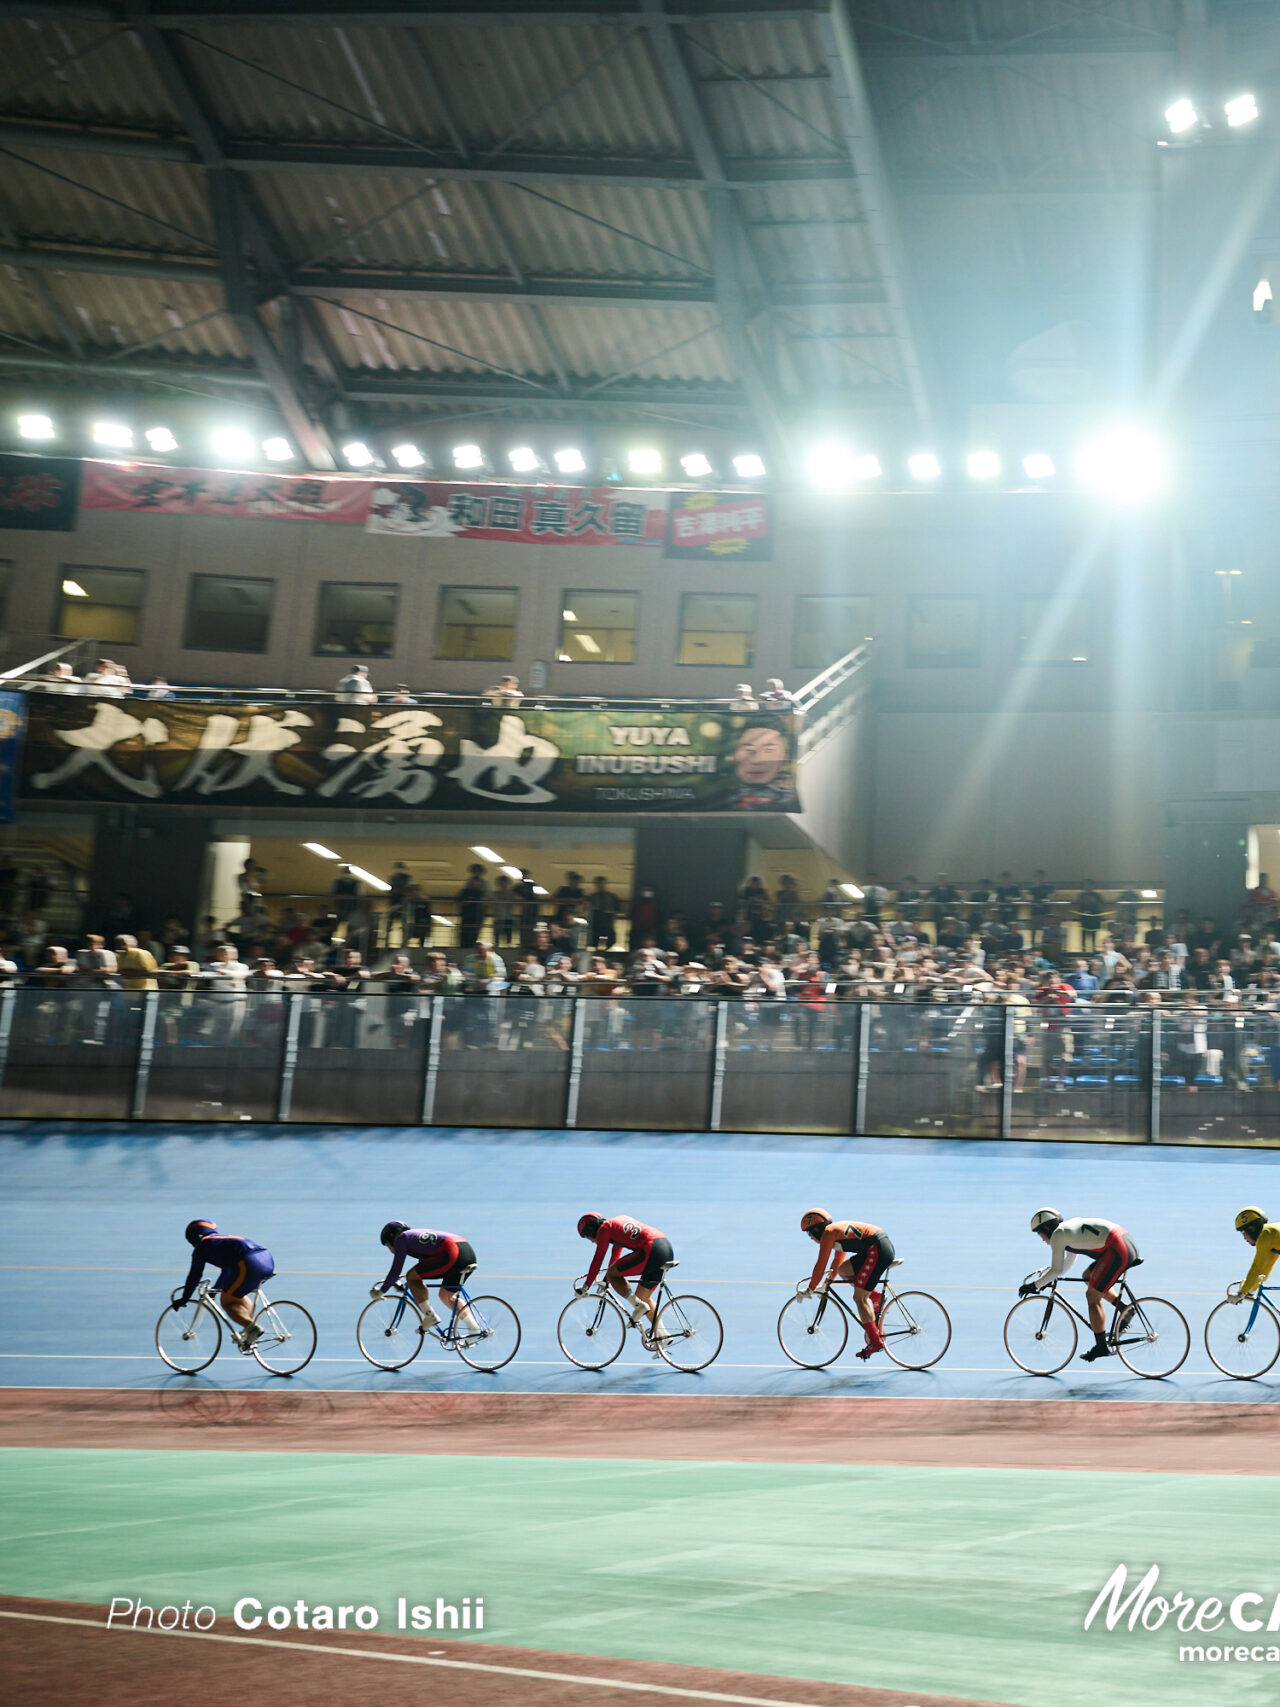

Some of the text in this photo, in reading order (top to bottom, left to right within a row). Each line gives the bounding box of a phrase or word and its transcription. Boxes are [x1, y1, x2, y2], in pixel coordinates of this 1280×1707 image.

[608, 725, 692, 746] YUYA
[576, 754, 717, 775] INUBUSHI
[1240, 1212, 1248, 1224] 5
[623, 1222, 642, 1239] 3
[844, 1224, 863, 1239] 7
